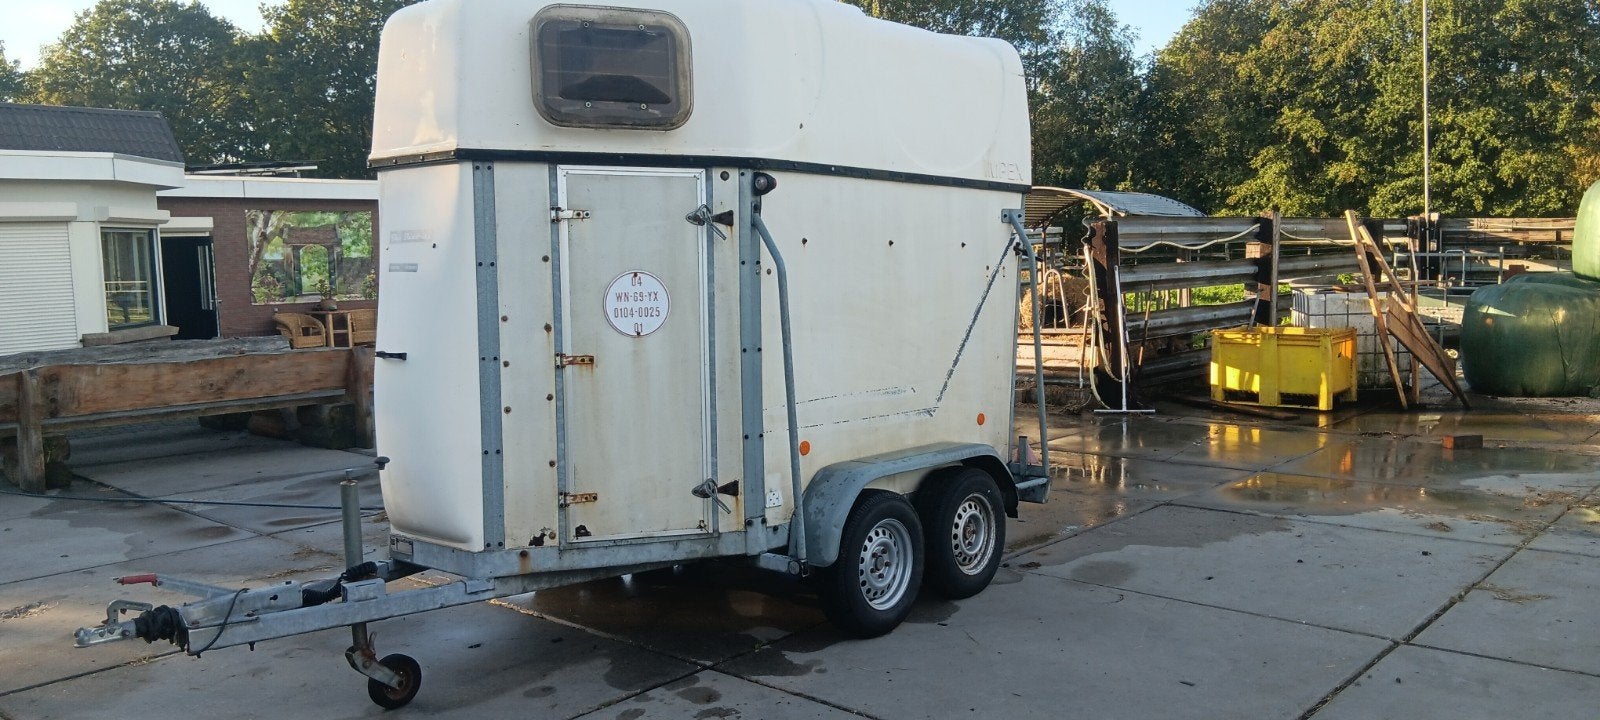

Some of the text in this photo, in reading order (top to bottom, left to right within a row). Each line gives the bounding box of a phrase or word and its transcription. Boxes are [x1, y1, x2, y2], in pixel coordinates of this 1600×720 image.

[631, 275, 642, 287] 04
[614, 307, 660, 318] 0104-0025
[634, 322, 643, 333] 01
